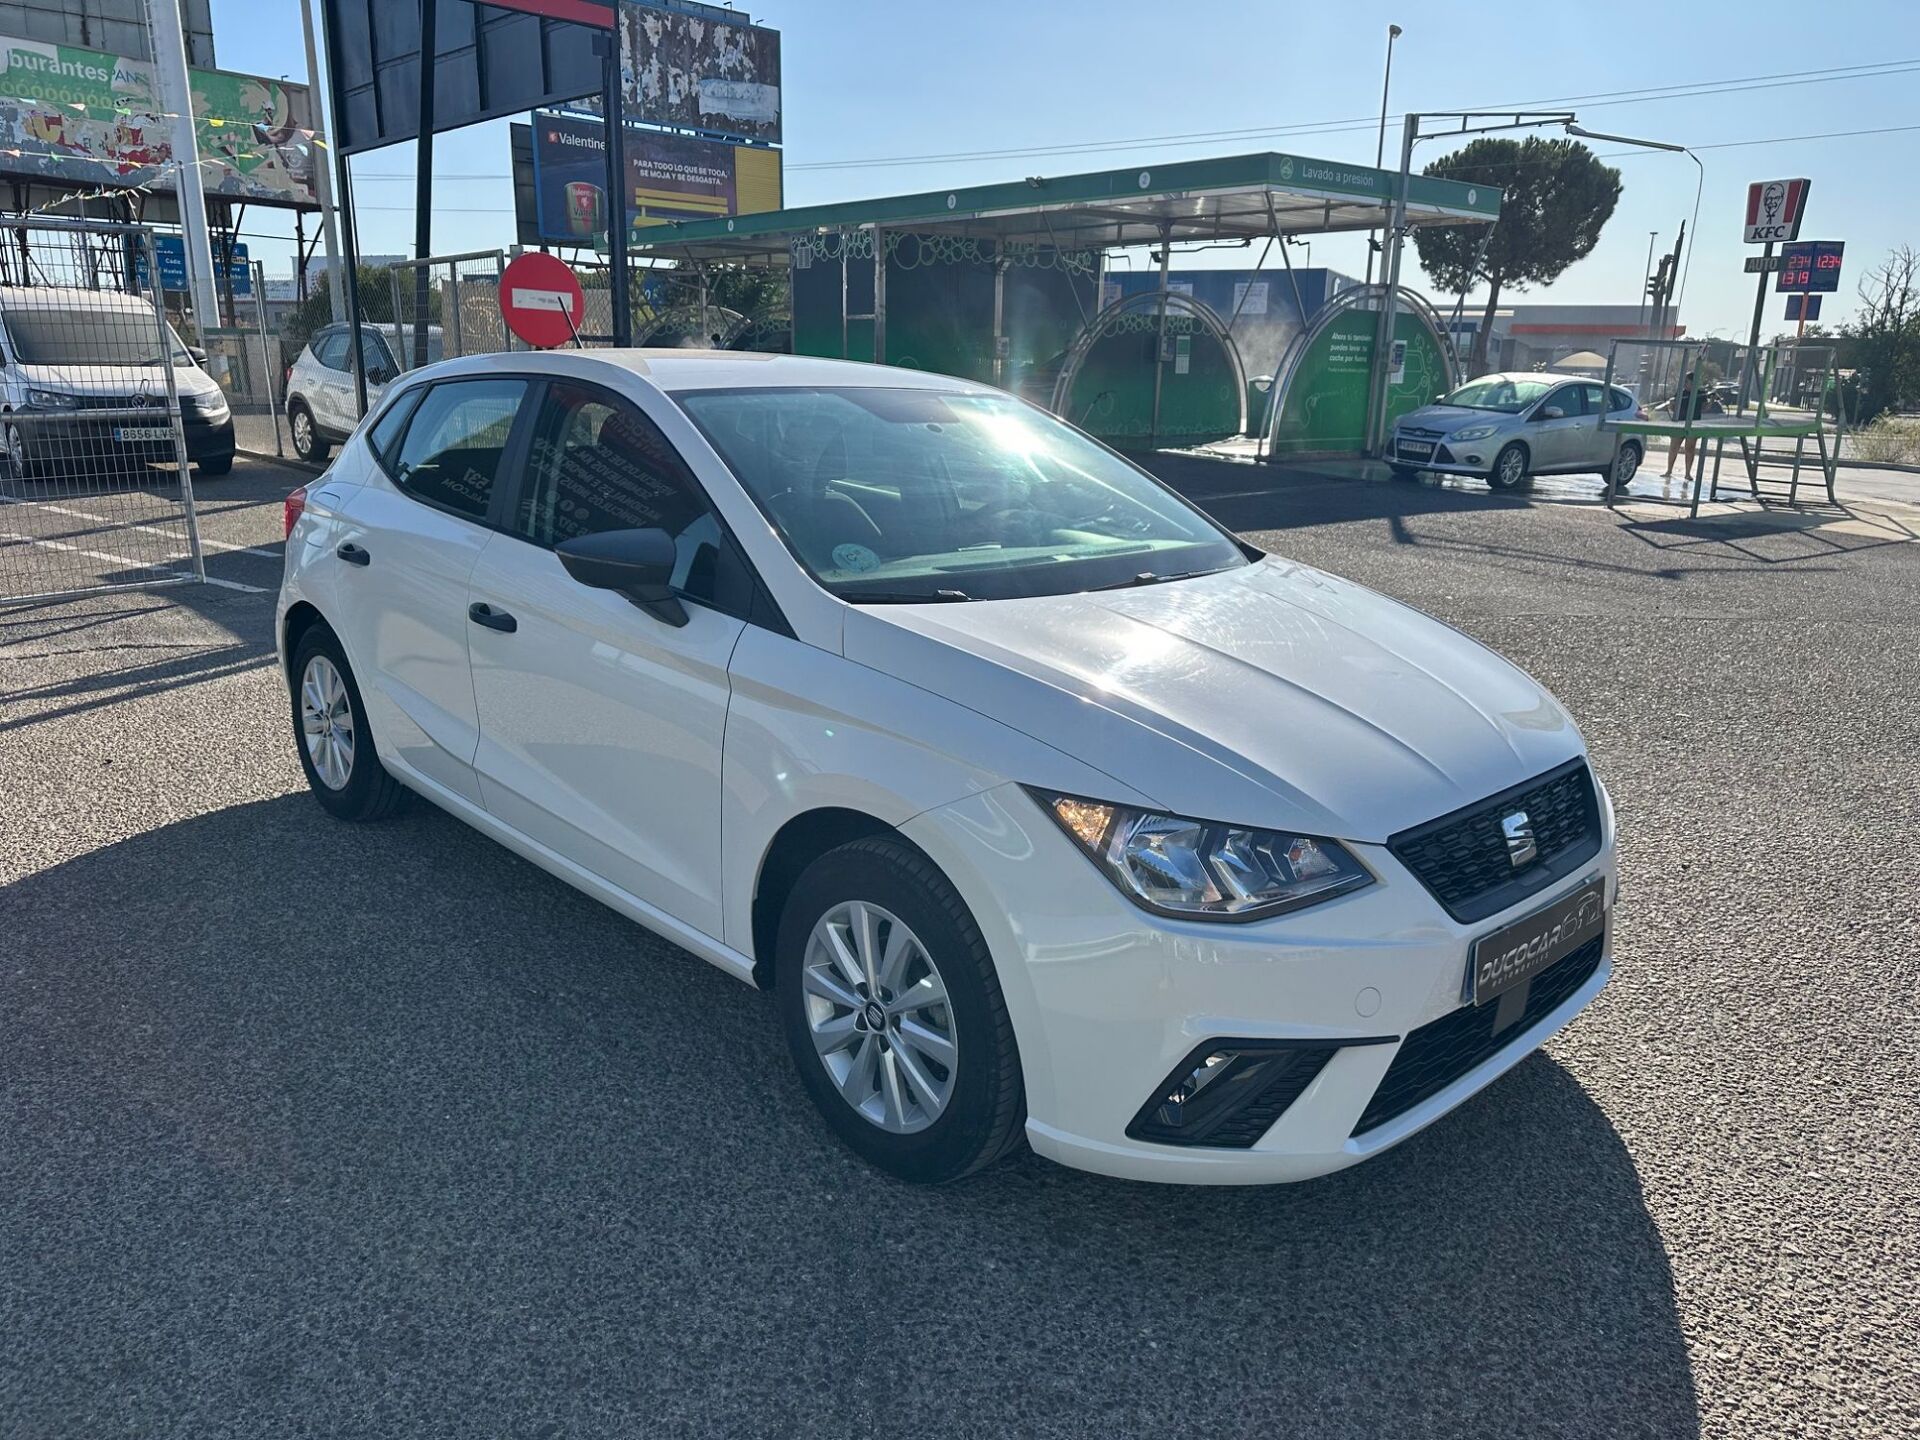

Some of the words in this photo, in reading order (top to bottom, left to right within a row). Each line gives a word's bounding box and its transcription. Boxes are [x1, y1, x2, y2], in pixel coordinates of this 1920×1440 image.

[9, 48, 109, 82] burantes
[633, 159, 652, 169] PARA
[653, 162, 673, 171] TODO
[674, 164, 683, 172] LO
[683, 166, 697, 174] QUE
[698, 167, 707, 175] SE
[640, 169, 649, 177] SE
[649, 171, 671, 180] MOJA
[677, 174, 686, 182] SE
[1302, 164, 1334, 181] Lavado
[1335, 173, 1341, 182] a
[1343, 172, 1374, 187] presión
[1751, 225, 1785, 239] KFC
[1748, 258, 1777, 271] AUTO
[123, 430, 151, 439] 8656
[1479, 924, 1561, 986] DUCOCAR
